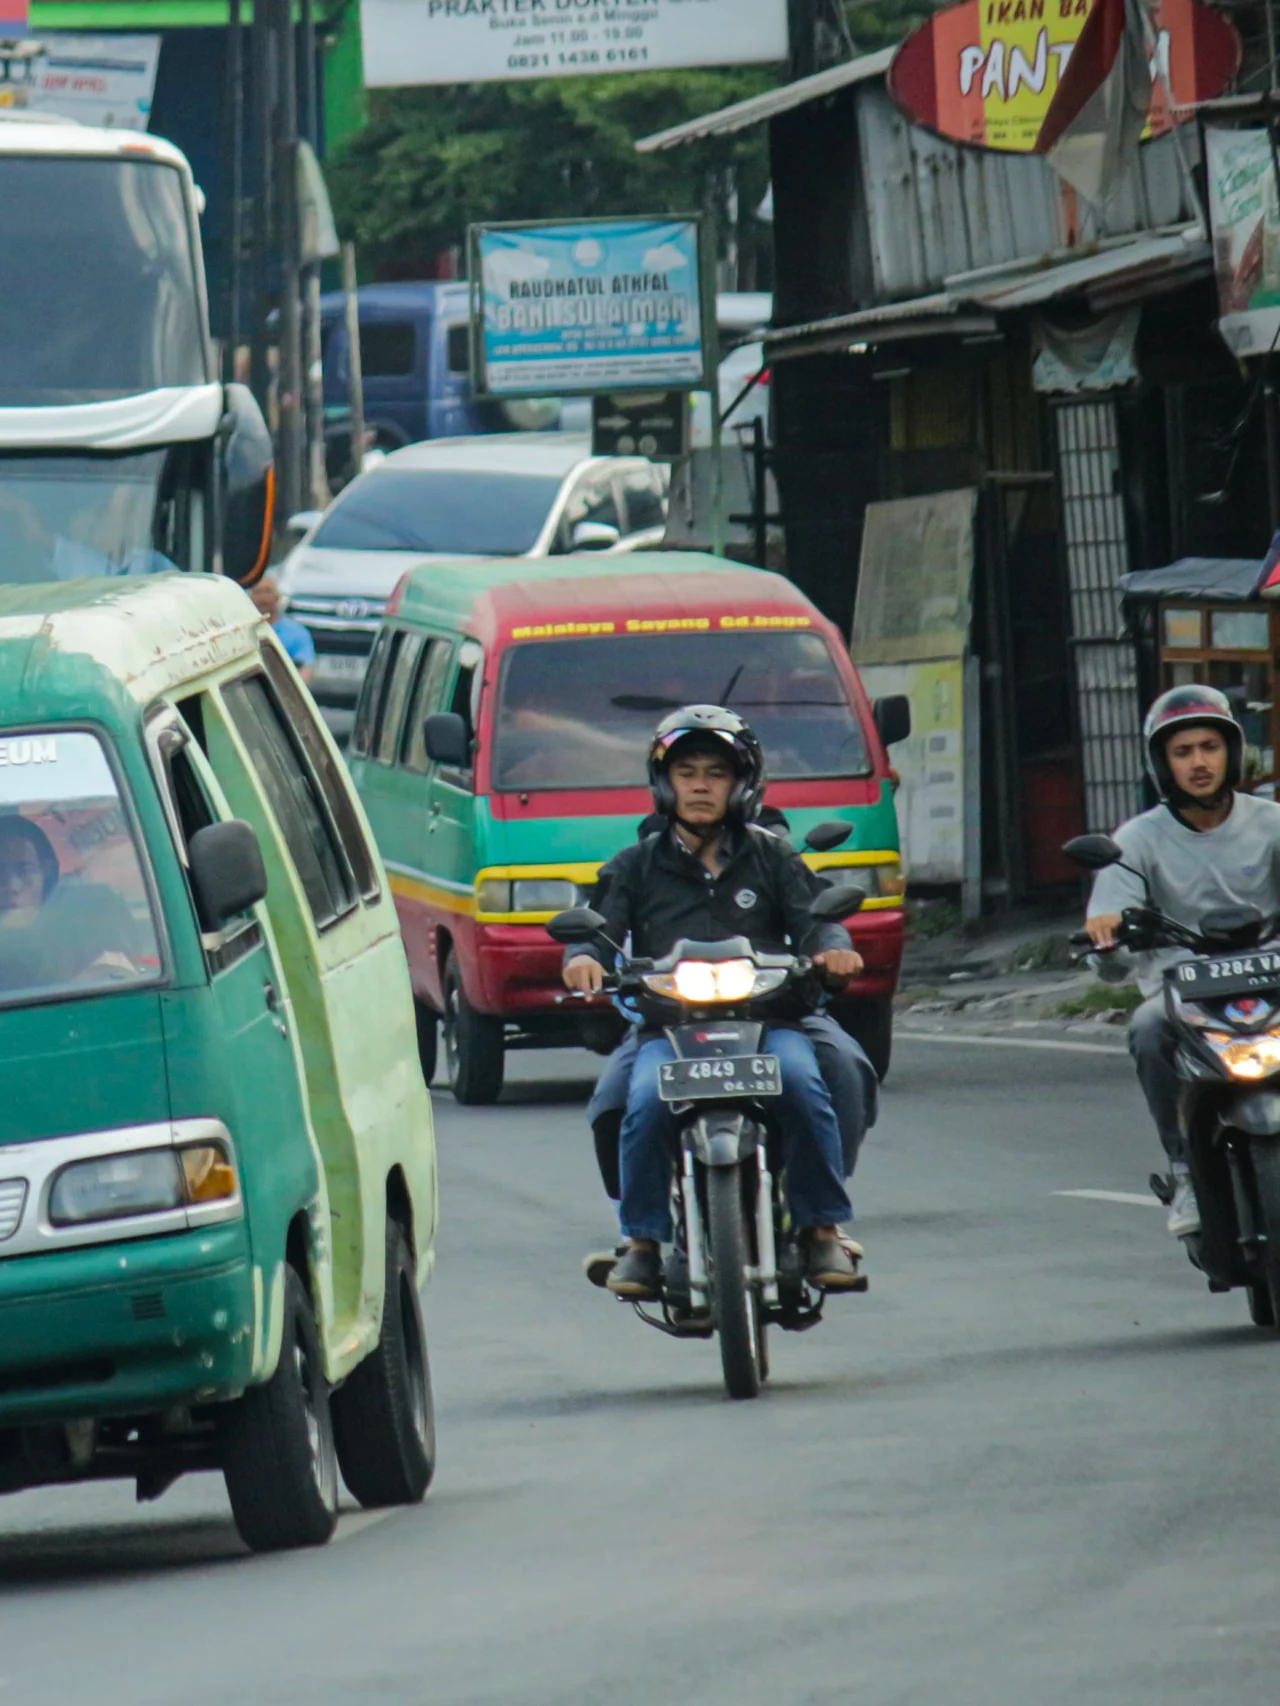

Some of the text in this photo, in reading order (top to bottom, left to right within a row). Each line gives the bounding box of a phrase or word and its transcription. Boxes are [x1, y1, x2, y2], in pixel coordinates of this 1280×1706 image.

[510, 272, 669, 298] RAUDHATUL ATHFAL
[663, 1059, 776, 1081] Z 4849 CV
